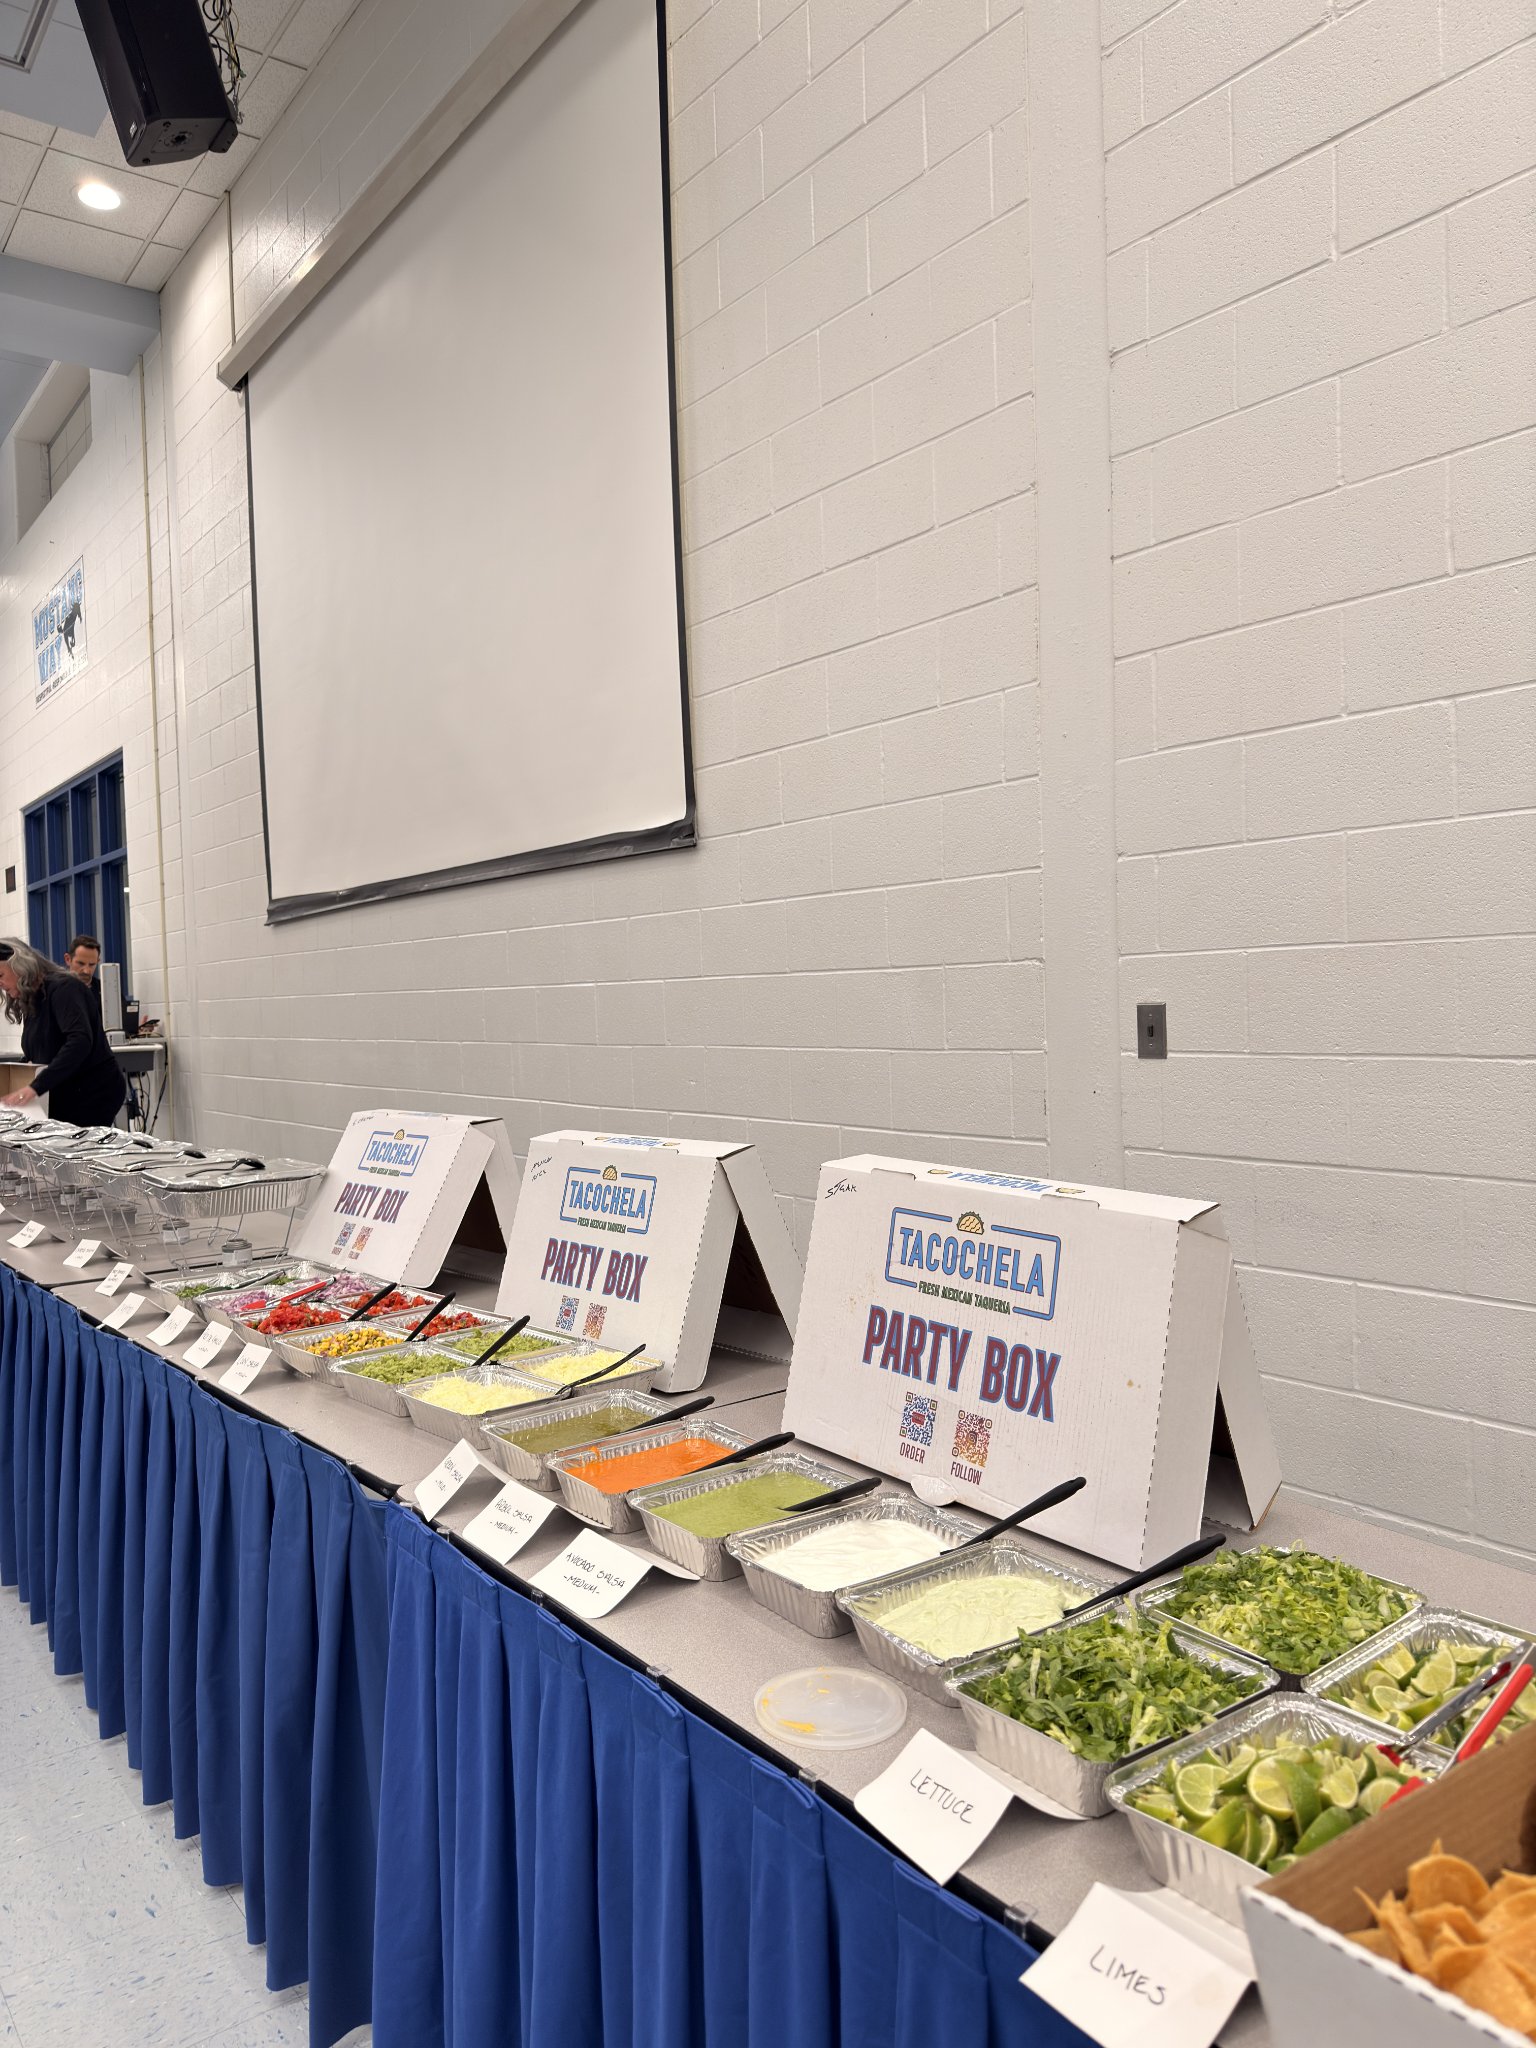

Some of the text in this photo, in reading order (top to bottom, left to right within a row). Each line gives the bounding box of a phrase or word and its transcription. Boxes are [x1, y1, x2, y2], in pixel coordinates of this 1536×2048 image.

[34, 569, 82, 650] MUSTANG
[38, 634, 62, 686] WAY
[367, 1140, 420, 1167] TACOCHELA
[334, 1181, 409, 1224] PARTY BOX
[569, 1180, 647, 1219] TACOCHELA
[947, 1172, 1053, 1193] TACOCHELA
[541, 1237, 648, 1303] PARTY BOX
[900, 1227, 1045, 1297] TACOCHELA
[918, 1281, 1010, 1315] FRESH MEXICAN TAQUERIA
[862, 1304, 1062, 1423] PARTY BOX
[900, 1442, 926, 1464] ORDER
[950, 1461, 982, 1486] FOLLOW
[512, 1509, 533, 1523] SALSA
[566, 1552, 626, 1588] AVOCADO SALSA
[910, 1768, 974, 1824] LETTUCE
[1090, 1944, 1166, 2006] LIMES
